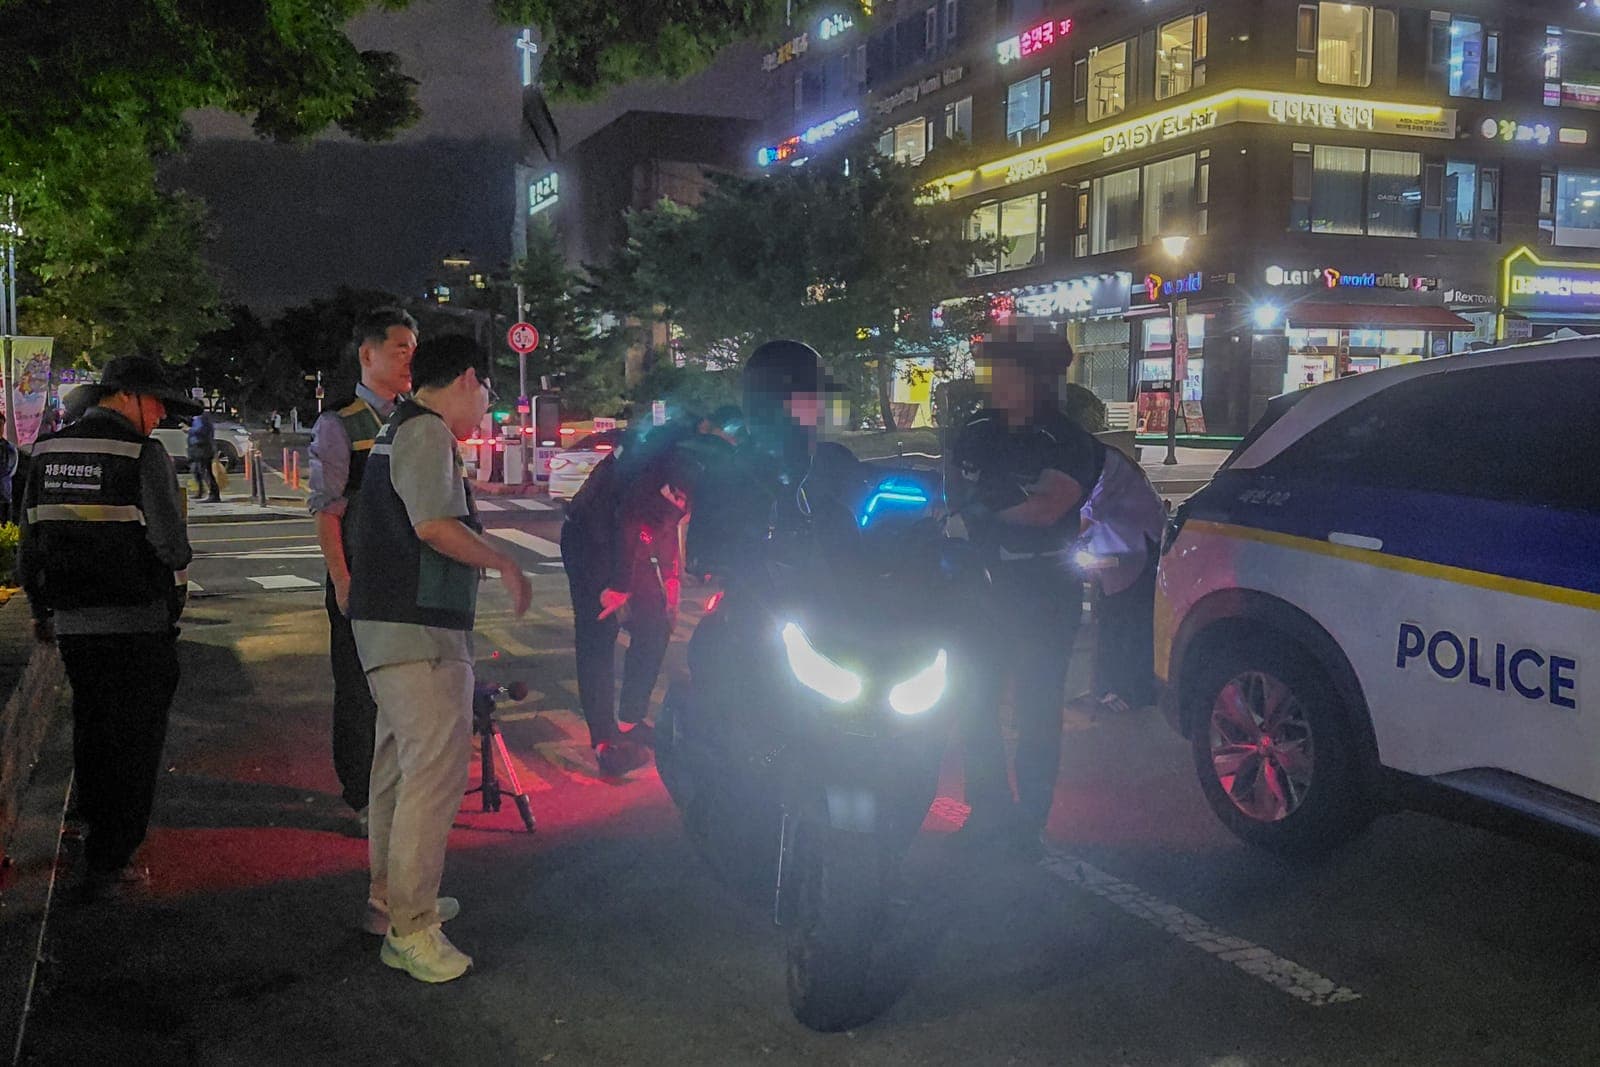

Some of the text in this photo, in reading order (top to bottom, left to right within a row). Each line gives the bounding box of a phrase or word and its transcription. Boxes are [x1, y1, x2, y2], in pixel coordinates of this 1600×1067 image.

[1340, 273, 1375, 289] world
[1376, 273, 1408, 289] olleh
[44, 463, 103, 478] 자동차안전단속
[1396, 623, 1576, 710] POLICE
